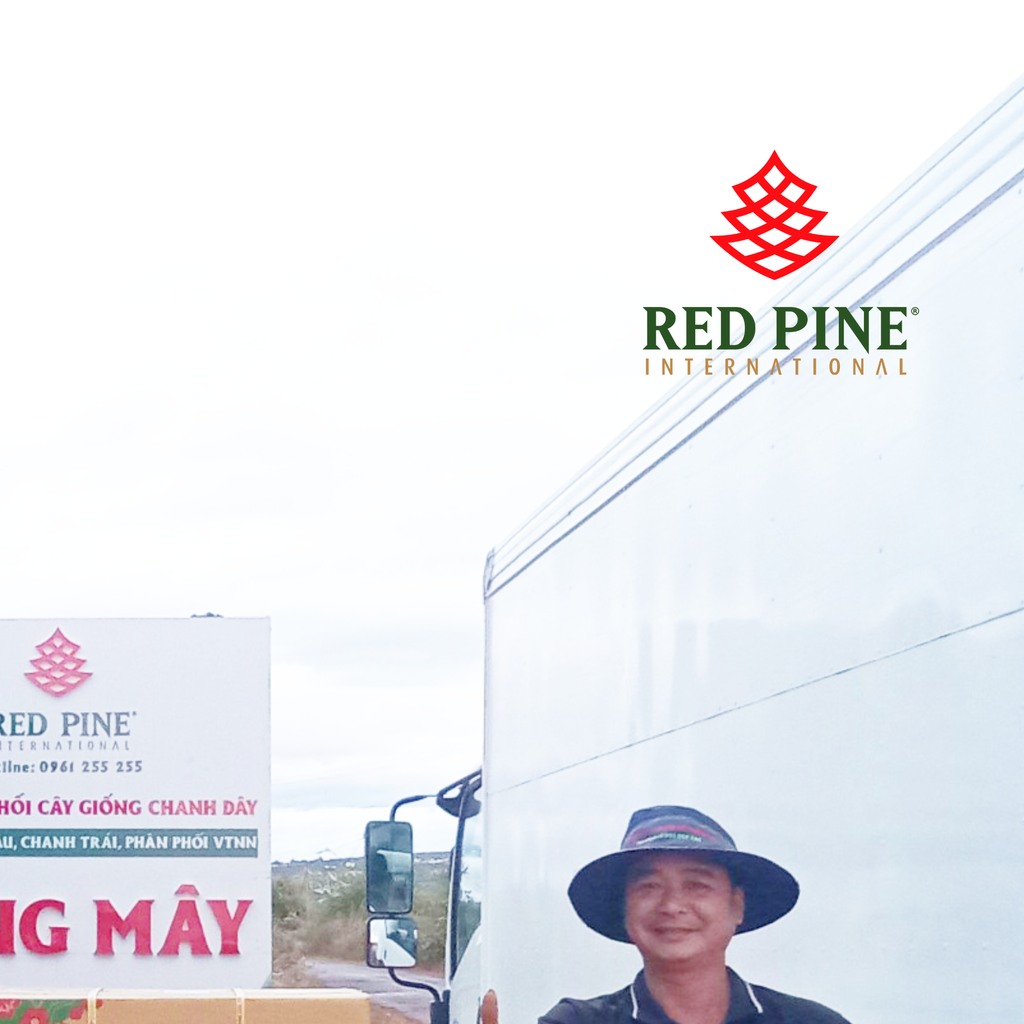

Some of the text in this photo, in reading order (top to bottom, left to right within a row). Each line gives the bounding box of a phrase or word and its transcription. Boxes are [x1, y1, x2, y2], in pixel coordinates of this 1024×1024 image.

[40, 761, 74, 773] 0961
[82, 761, 108, 773] 255
[116, 760, 143, 772] 255
[38, 796, 74, 815] CÂY
[79, 793, 141, 815] GIỐNG
[148, 799, 216, 815] CHANH
[223, 796, 258, 815] DÂY
[21, 836, 76, 849] CHANH
[125, 833, 169, 849] PHÂN
[172, 832, 209, 849] PHỐI
[213, 836, 257, 849] VTNN
[93, 883, 254, 957] MÂY
